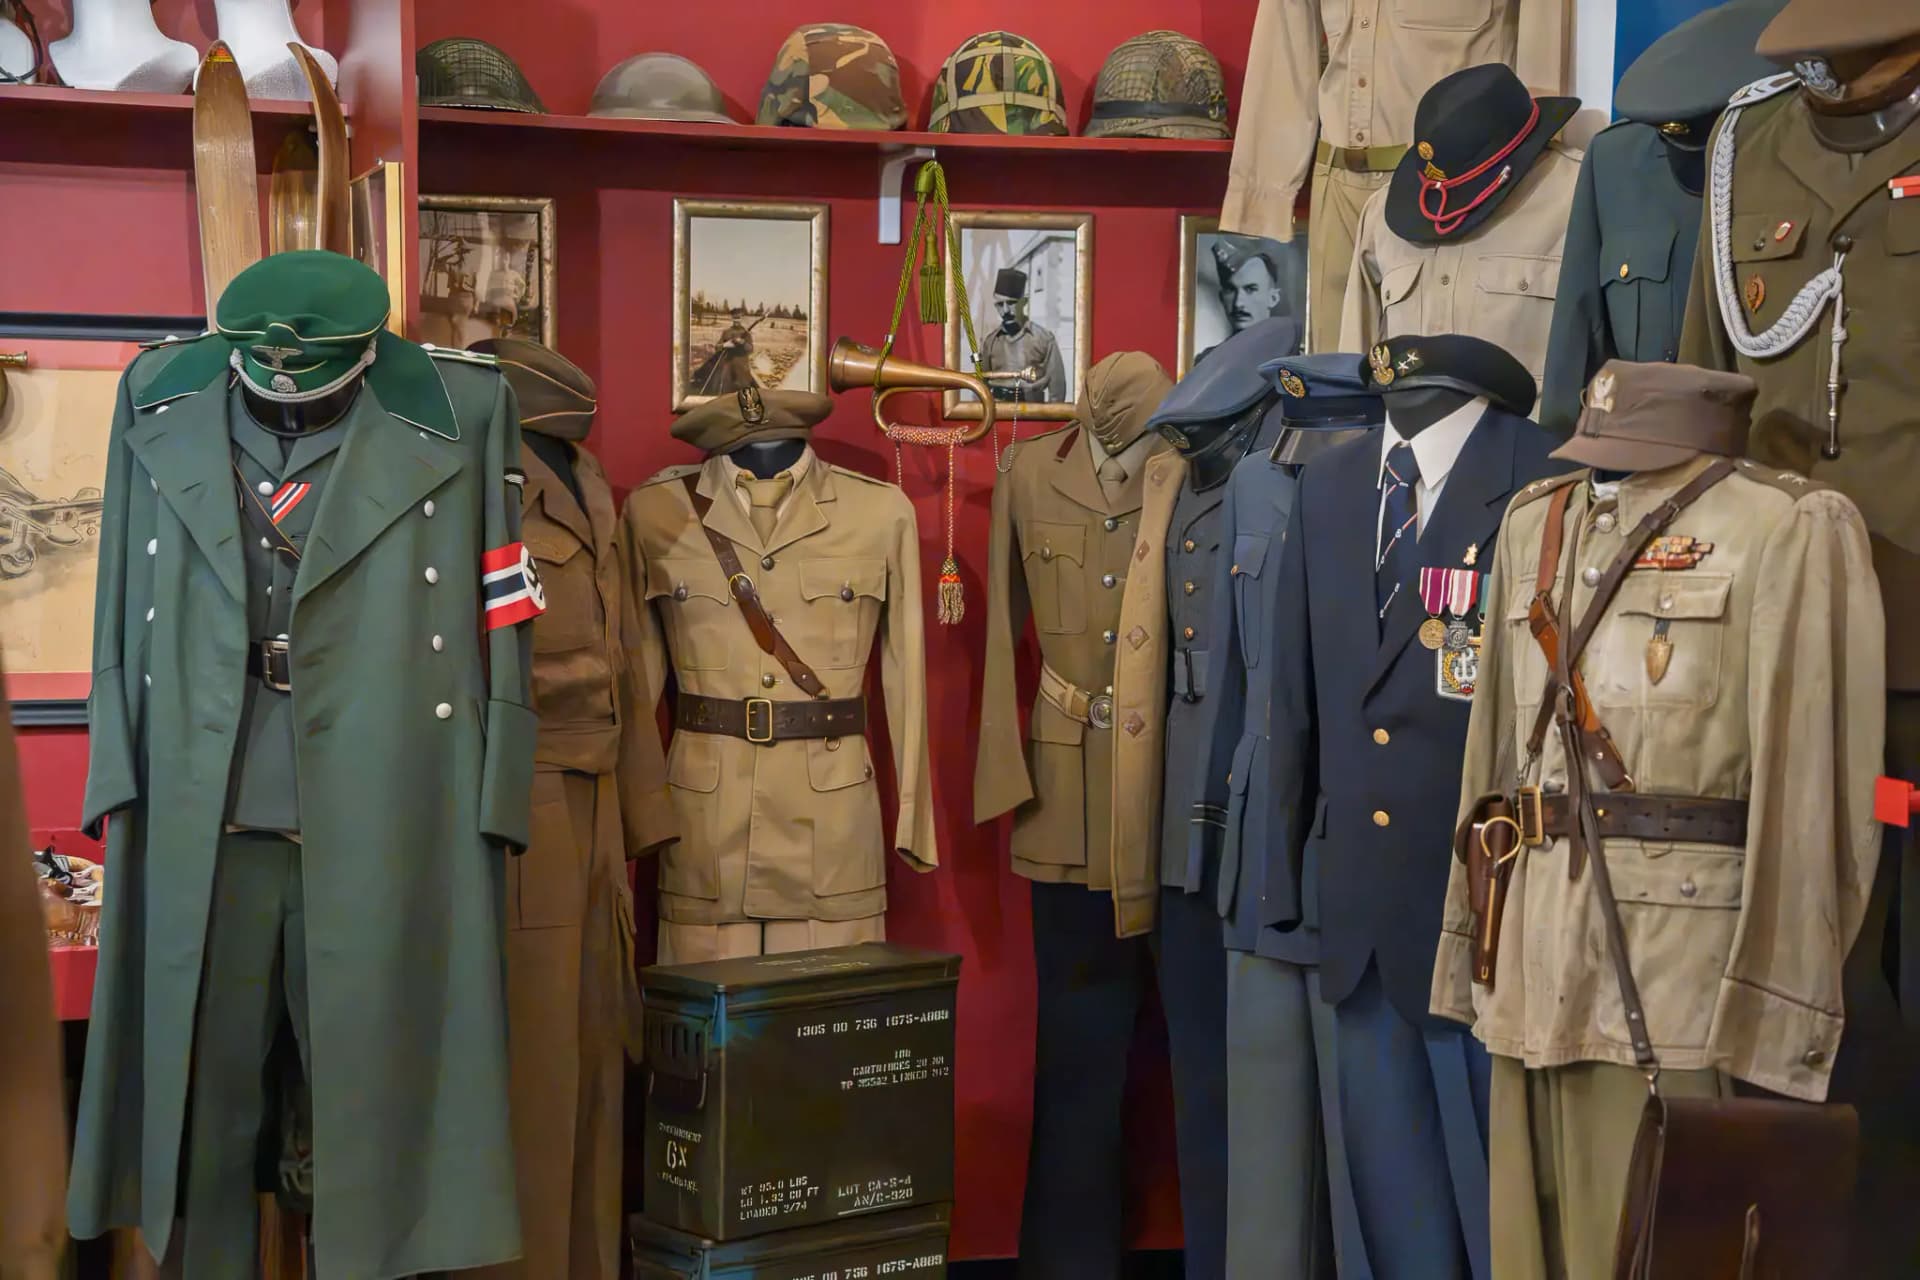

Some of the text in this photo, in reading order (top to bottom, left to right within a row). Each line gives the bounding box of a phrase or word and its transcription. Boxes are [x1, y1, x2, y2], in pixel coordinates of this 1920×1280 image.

[797, 1024, 826, 1038] 1305
[833, 1022, 848, 1033] 00
[855, 1018, 878, 1031] 756
[840, 1080, 853, 1091] TP
[790, 1176, 809, 1188] LBS
[807, 1186, 819, 1197] FT
[838, 1184, 861, 1198] LOT
[844, 1266, 868, 1280] 756
